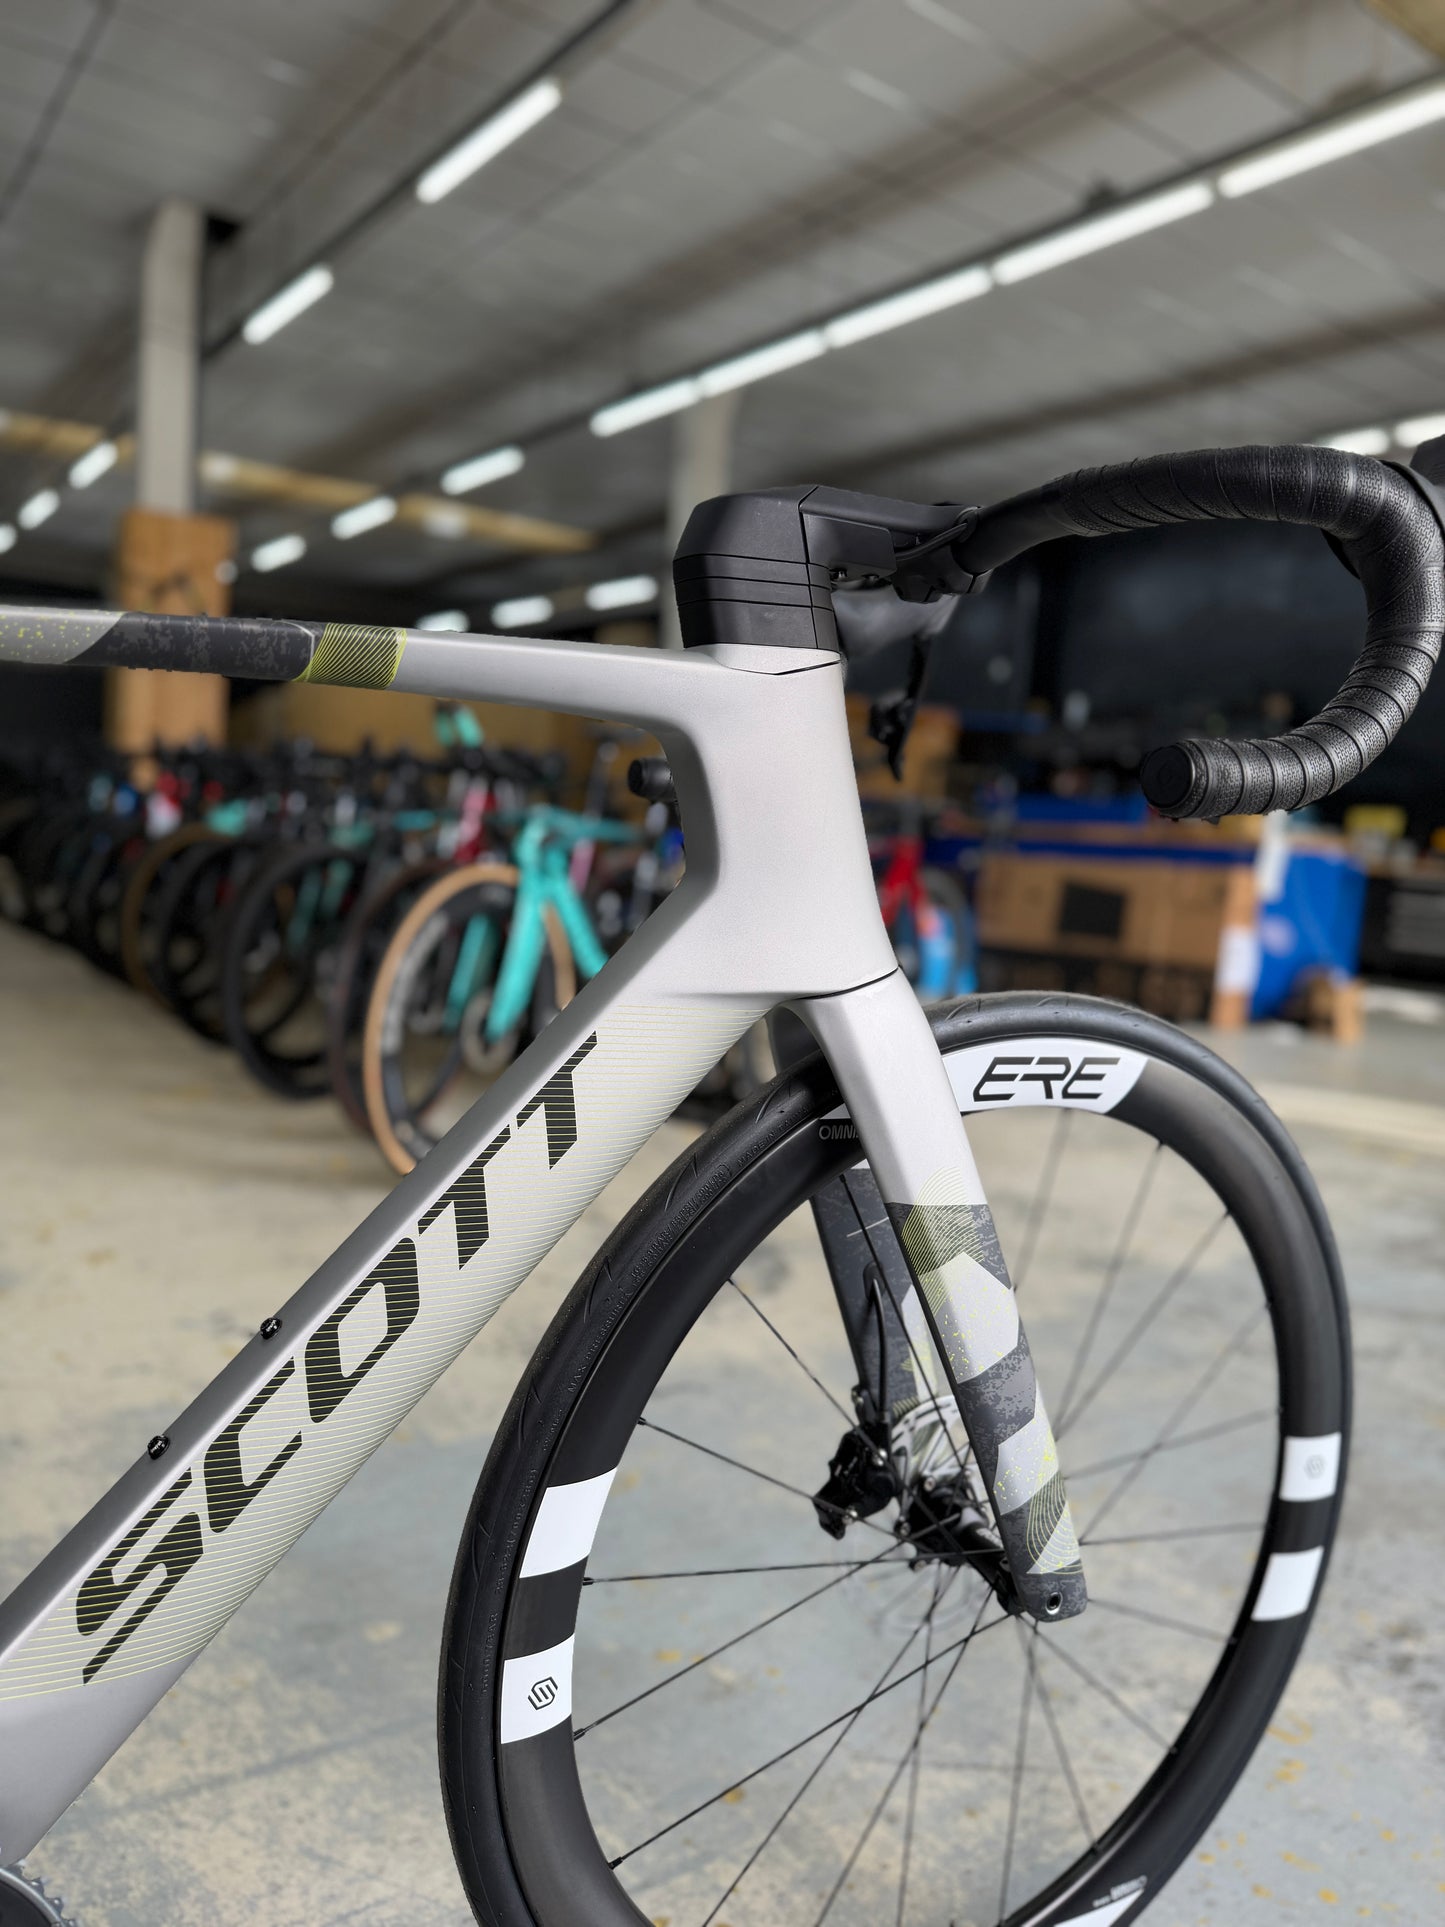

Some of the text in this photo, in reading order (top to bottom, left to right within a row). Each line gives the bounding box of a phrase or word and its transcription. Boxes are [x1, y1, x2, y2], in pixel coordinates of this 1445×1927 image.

[972, 1056, 1121, 1103] ERE
[818, 1124, 860, 1141] OMNI
[75, 1031, 597, 1684] SCOTT
